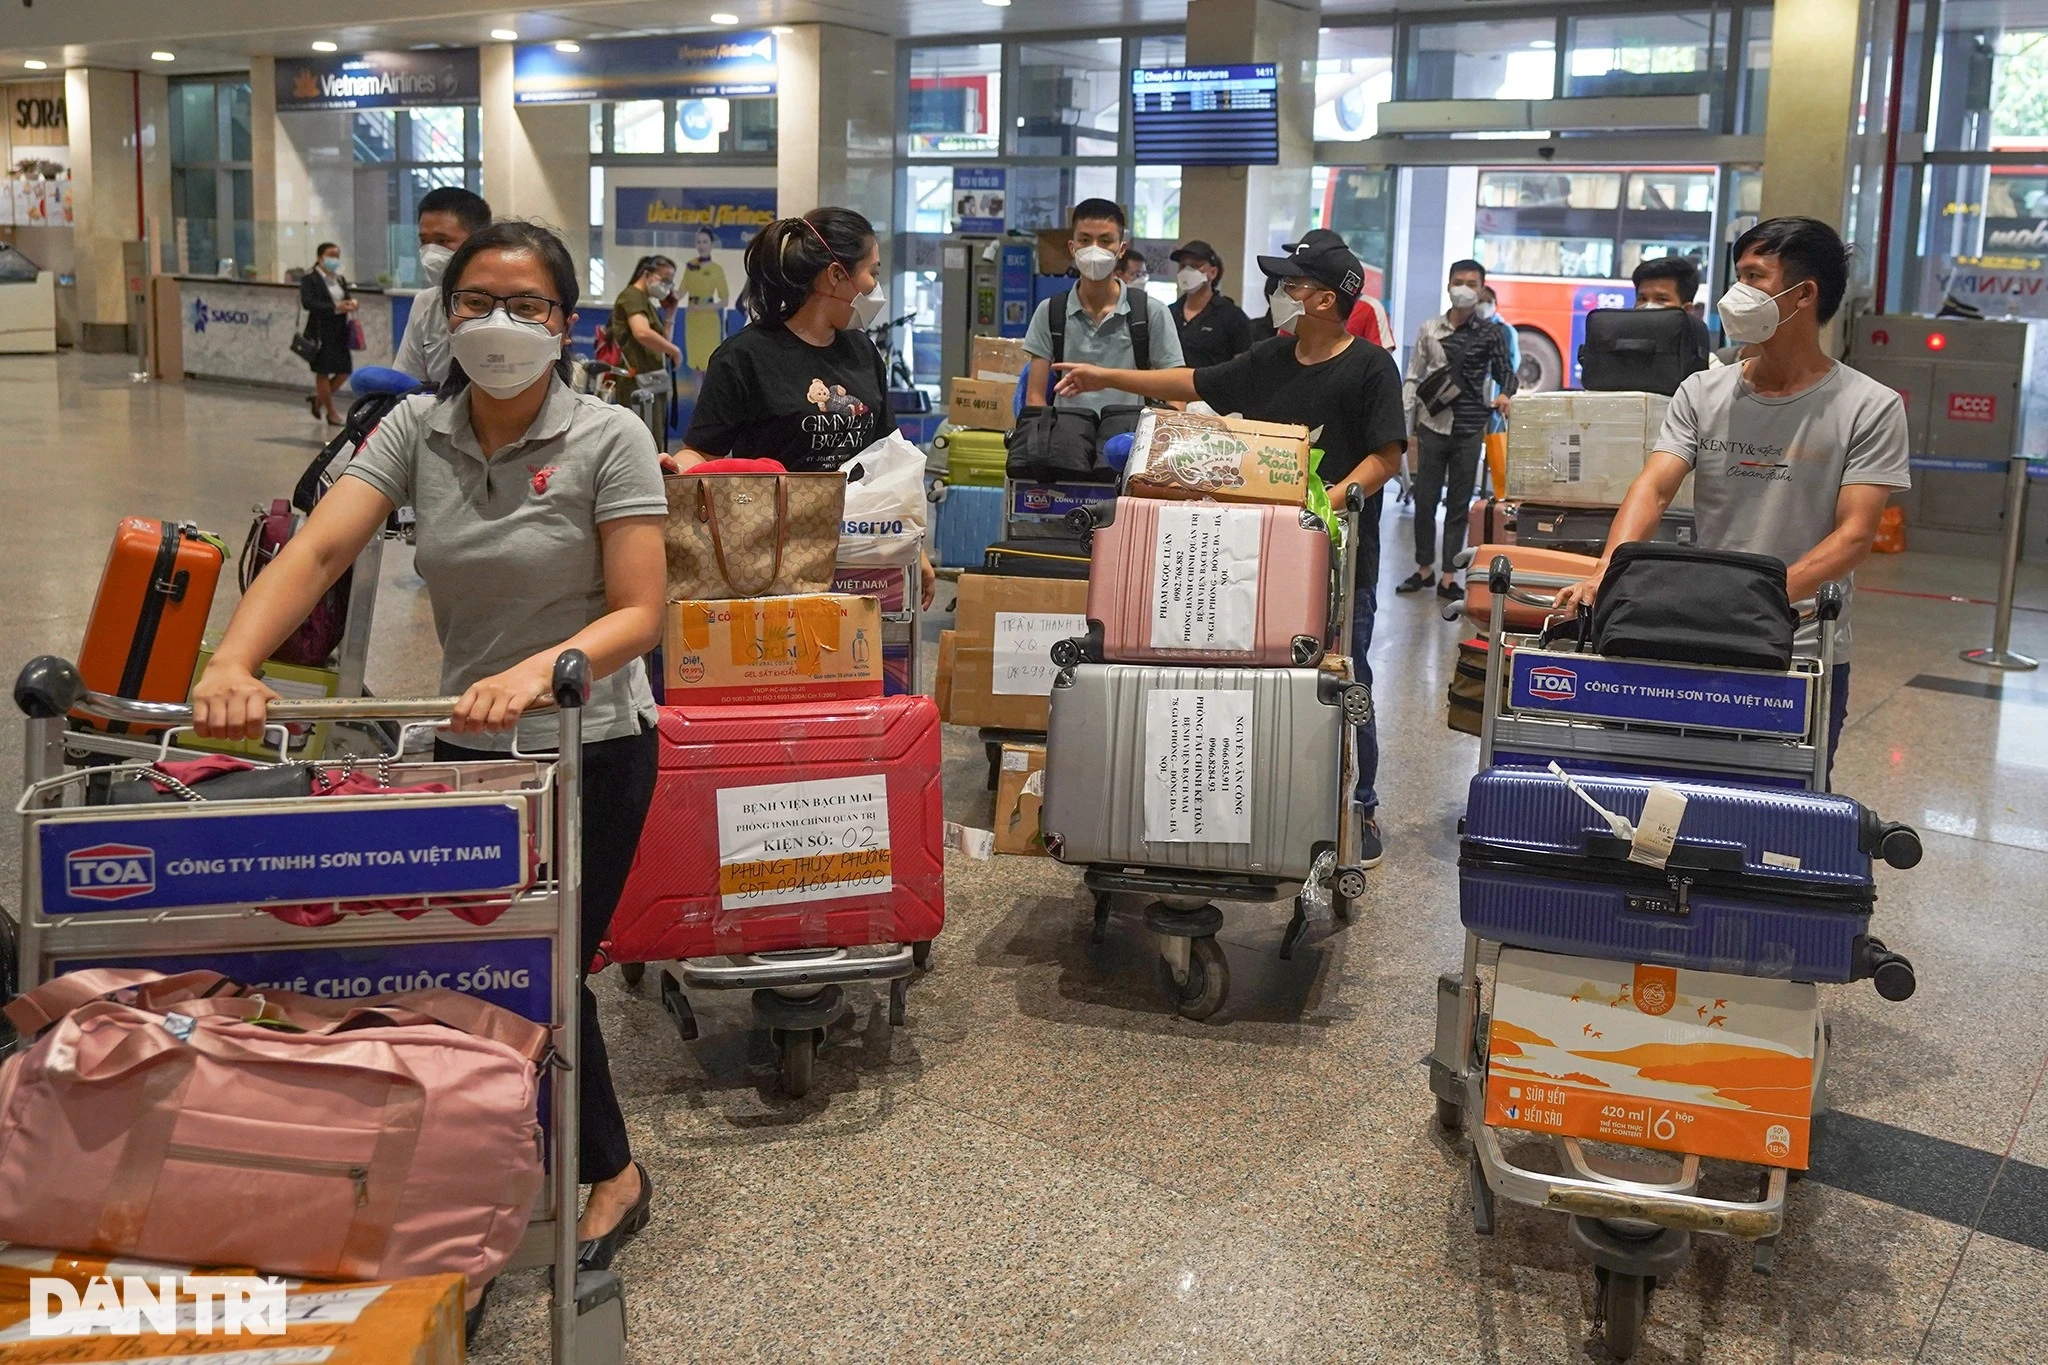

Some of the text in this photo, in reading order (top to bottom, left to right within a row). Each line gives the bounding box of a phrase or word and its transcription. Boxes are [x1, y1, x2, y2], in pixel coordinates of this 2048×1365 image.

[320, 71, 436, 97] Vietnam Airlines
[646, 200, 776, 228] Vietravel Airlines
[211, 310, 249, 325] SASCO
[487, 354, 505, 363] 3M
[1954, 397, 1991, 412] PCCC
[801, 412, 874, 432] GIMME A
[811, 431, 866, 450] BREAK
[1027, 494, 1048, 503] TOA
[836, 578, 888, 591] VIỆT NAM
[1159, 533, 1172, 619] PHẠM NGỌC LUÂN
[1183, 610, 1192, 641] PHÒNG
[1191, 513, 1200, 527] TRỊ
[1001, 615, 1072, 632] TRẦN THANH
[1207, 633, 1215, 642] 78
[682, 655, 701, 666] Diệt
[744, 671, 757, 679] GEL
[758, 668, 773, 678] SÁT
[1535, 675, 1572, 692] TOA
[1171, 697, 1179, 706] 78
[1584, 680, 1794, 710] CÔNG TY TNHH SƠN TOA VIỆT NAM
[1195, 696, 1206, 732] PHÒNG
[1195, 733, 1204, 751] TÀI
[1194, 753, 1204, 789] CHÍNH
[1222, 737, 1230, 792] 0966.053.911
[1234, 716, 1245, 815] NGUYỄN VĂN CÔNG
[743, 793, 872, 815] BỆNH VIỆN BẠCH MAI
[736, 821, 770, 832] PHÒNG
[772, 819, 799, 829] HÀNH
[800, 817, 831, 827] CHÍNH
[861, 812, 876, 821] TRỊ
[1194, 806, 1204, 835] TOÁN
[763, 837, 803, 852] KIỆN
[841, 825, 878, 848] 02
[166, 845, 501, 876] CÔNG TY TNHH SƠN TOA VIỆT NAM
[73, 860, 148, 885] TOA
[314, 978, 372, 998] CHO
[456, 964, 530, 991] SỐNG
[1526, 1084, 1566, 1105] SỮA YẾN
[1524, 1103, 1563, 1127] YẾN SÀO
[1601, 1105, 1695, 1140] 420 ml 6 hộp
[1600, 1119, 1644, 1133] THỂ TÍCH THỰC
[1612, 1128, 1643, 1138] CONTENT
[1769, 1144, 1787, 1154] 18%
